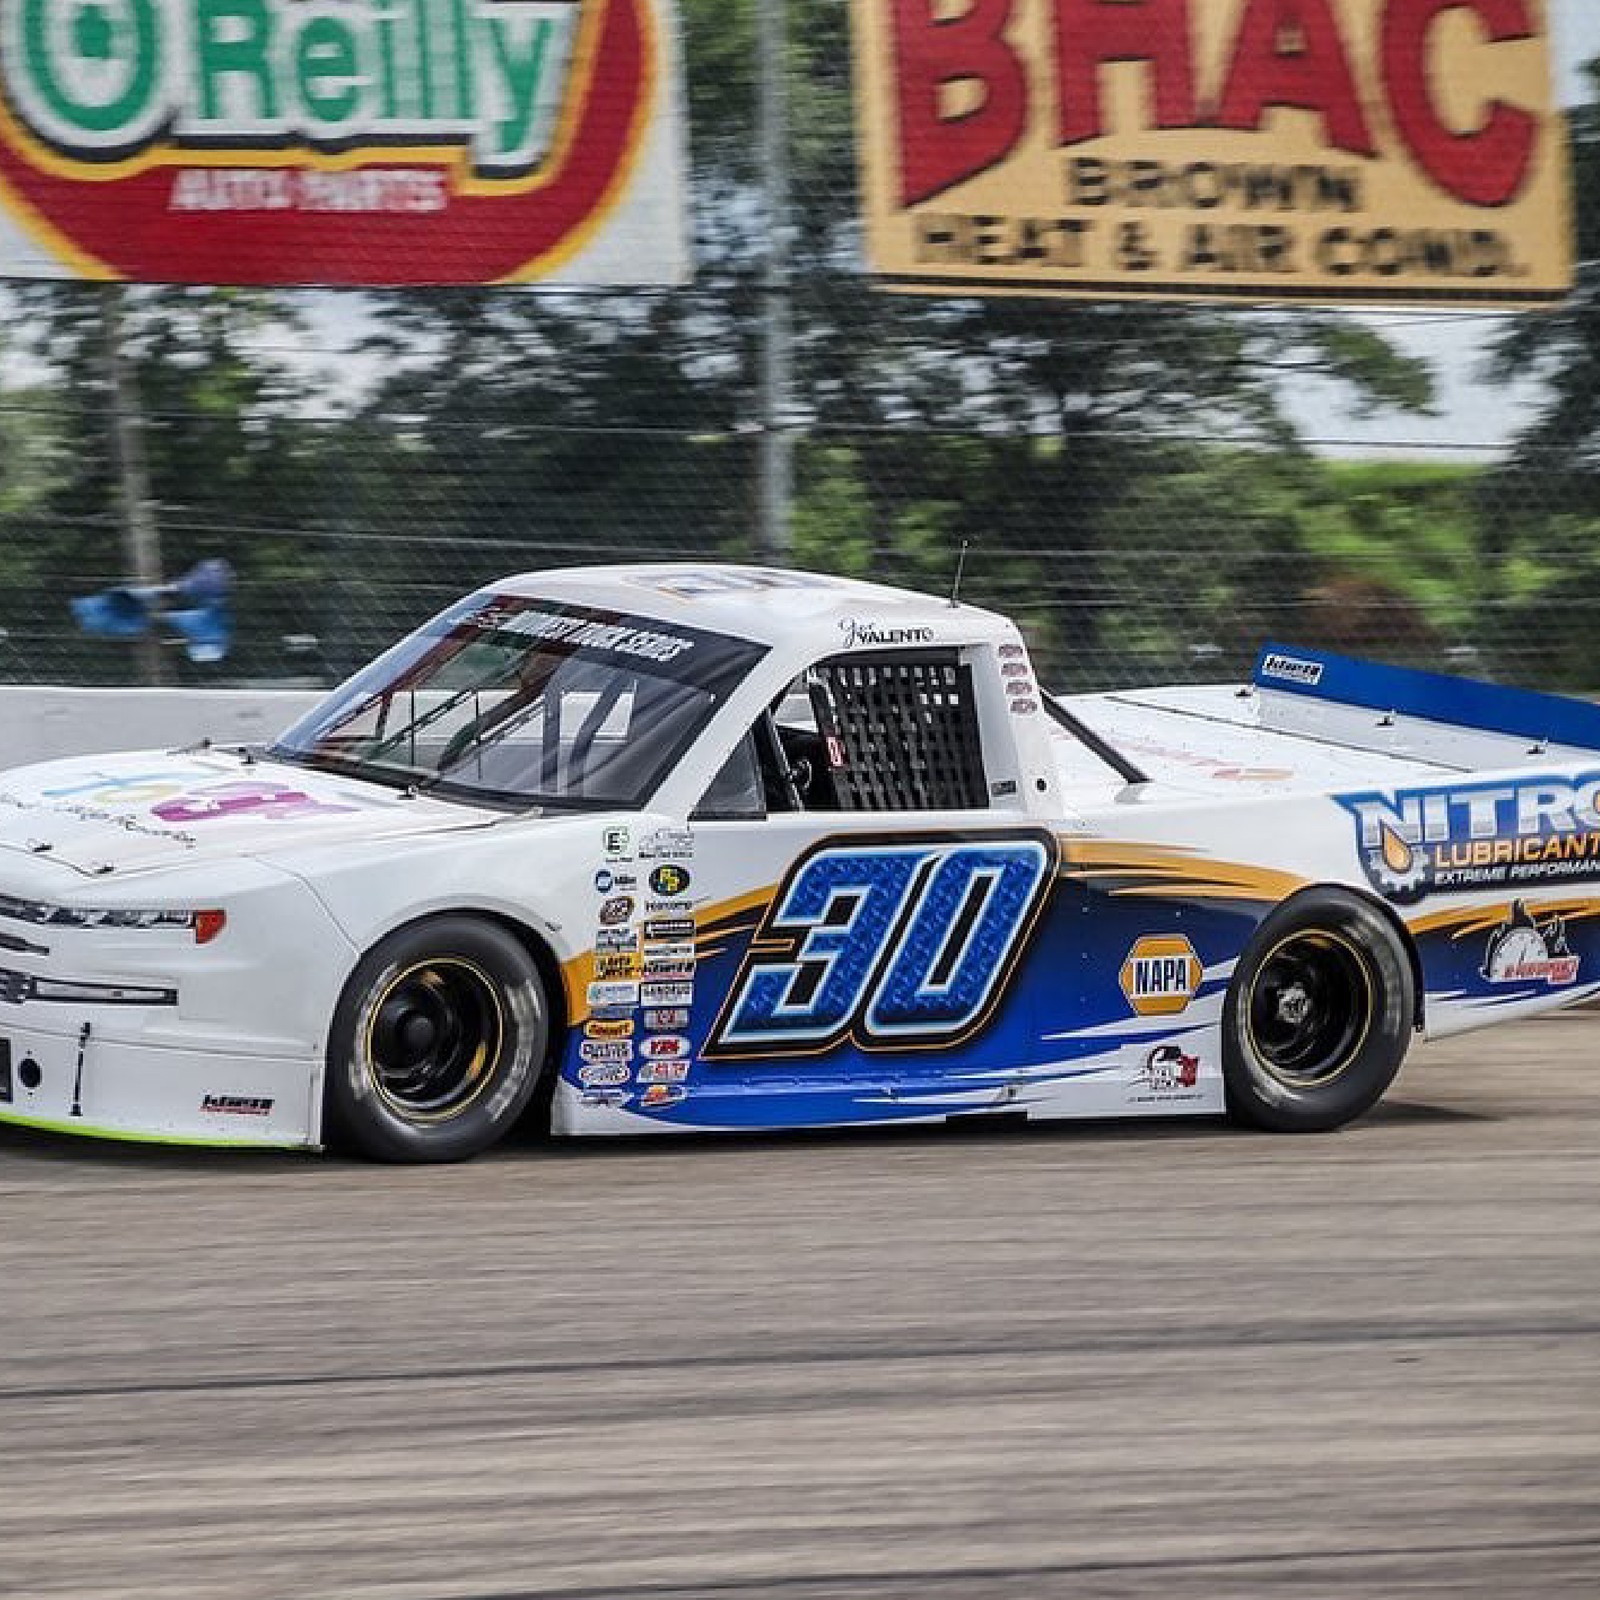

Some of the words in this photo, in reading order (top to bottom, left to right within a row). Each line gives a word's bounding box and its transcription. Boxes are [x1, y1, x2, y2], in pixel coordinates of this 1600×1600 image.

[895, 0, 1535, 208] BHAC
[1066, 157, 1363, 211] BROWN
[914, 213, 1091, 267] HEAT
[1112, 219, 1158, 272] &
[1178, 221, 1302, 274] AIR
[856, 626, 935, 645] VALENTO
[1434, 866, 1507, 885] EXTREME
[717, 839, 1049, 1044] 30
[1135, 958, 1187, 994] NAPA
